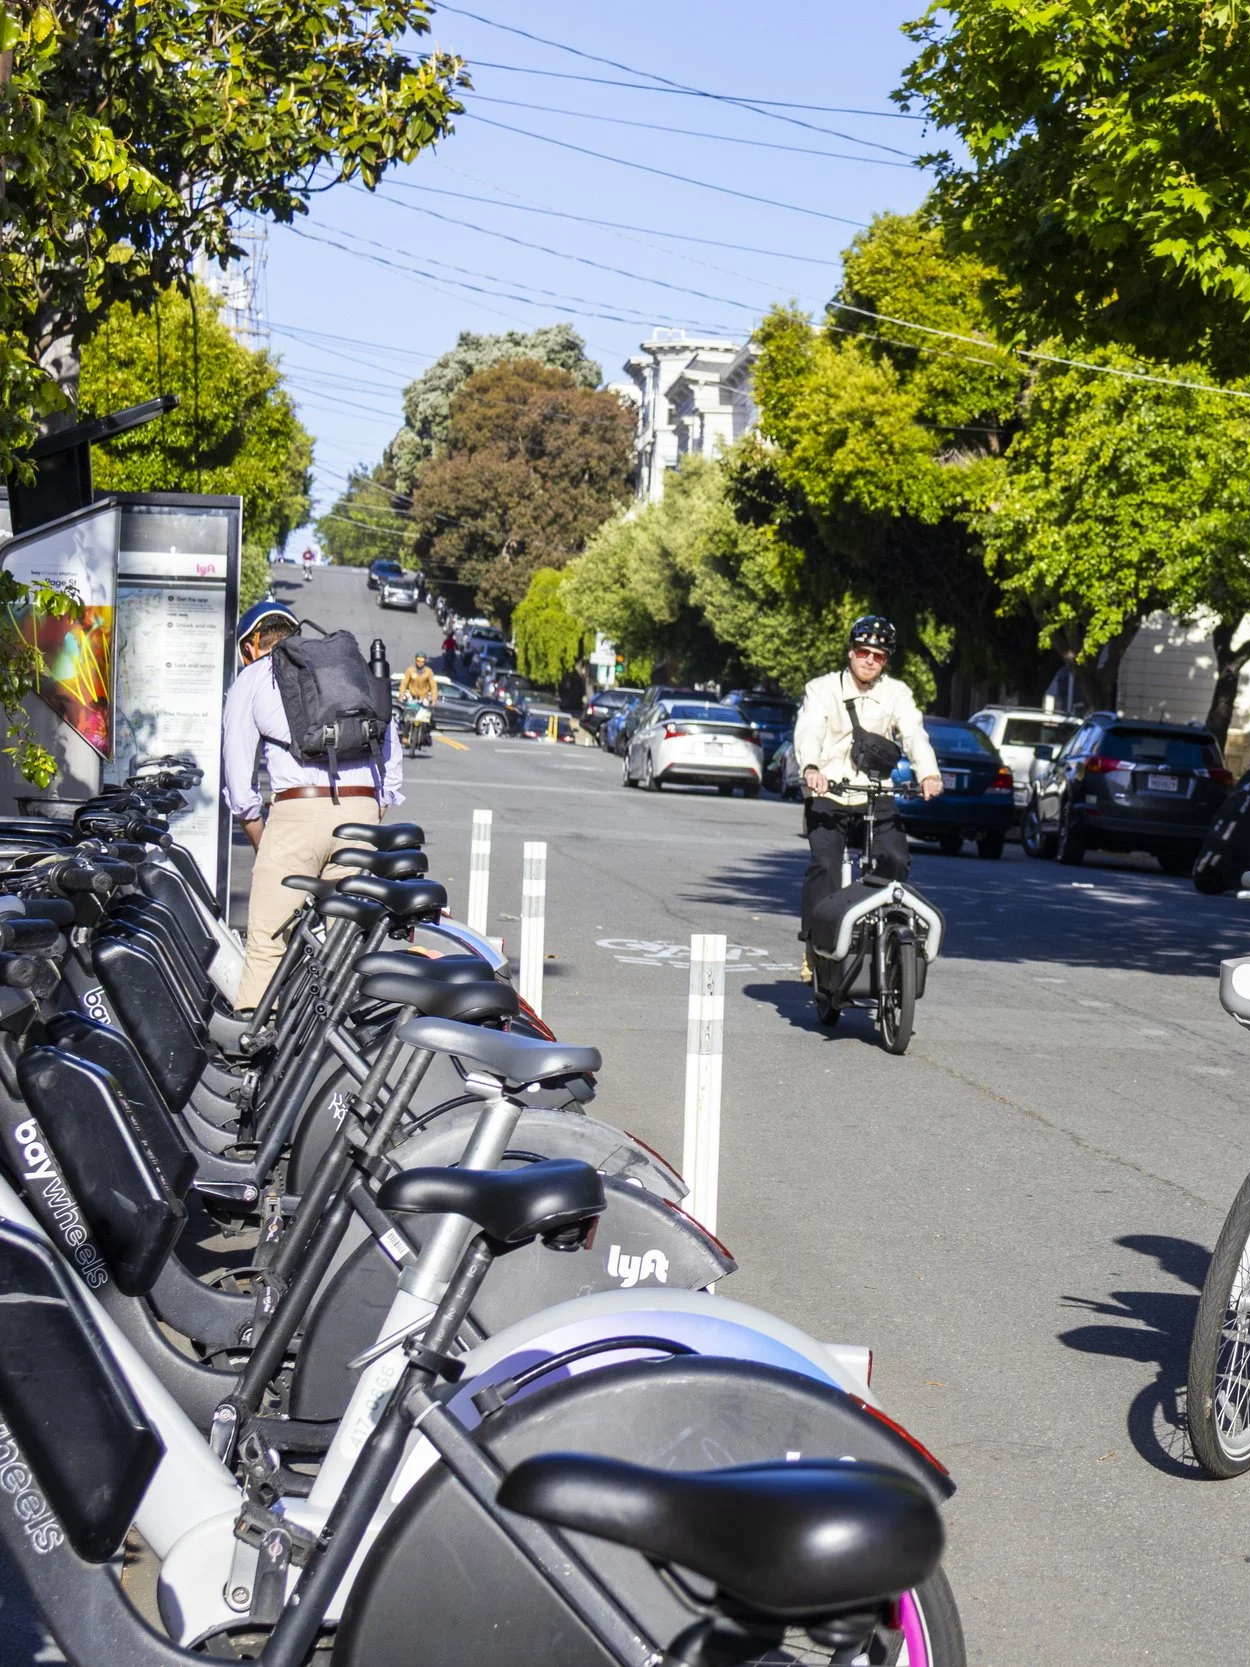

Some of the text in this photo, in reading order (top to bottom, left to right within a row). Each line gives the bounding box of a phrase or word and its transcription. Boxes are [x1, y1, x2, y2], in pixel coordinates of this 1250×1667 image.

[196, 563, 216, 577] lyft
[45, 578, 77, 588] Page St
[607, 1244, 669, 1288] lyft
